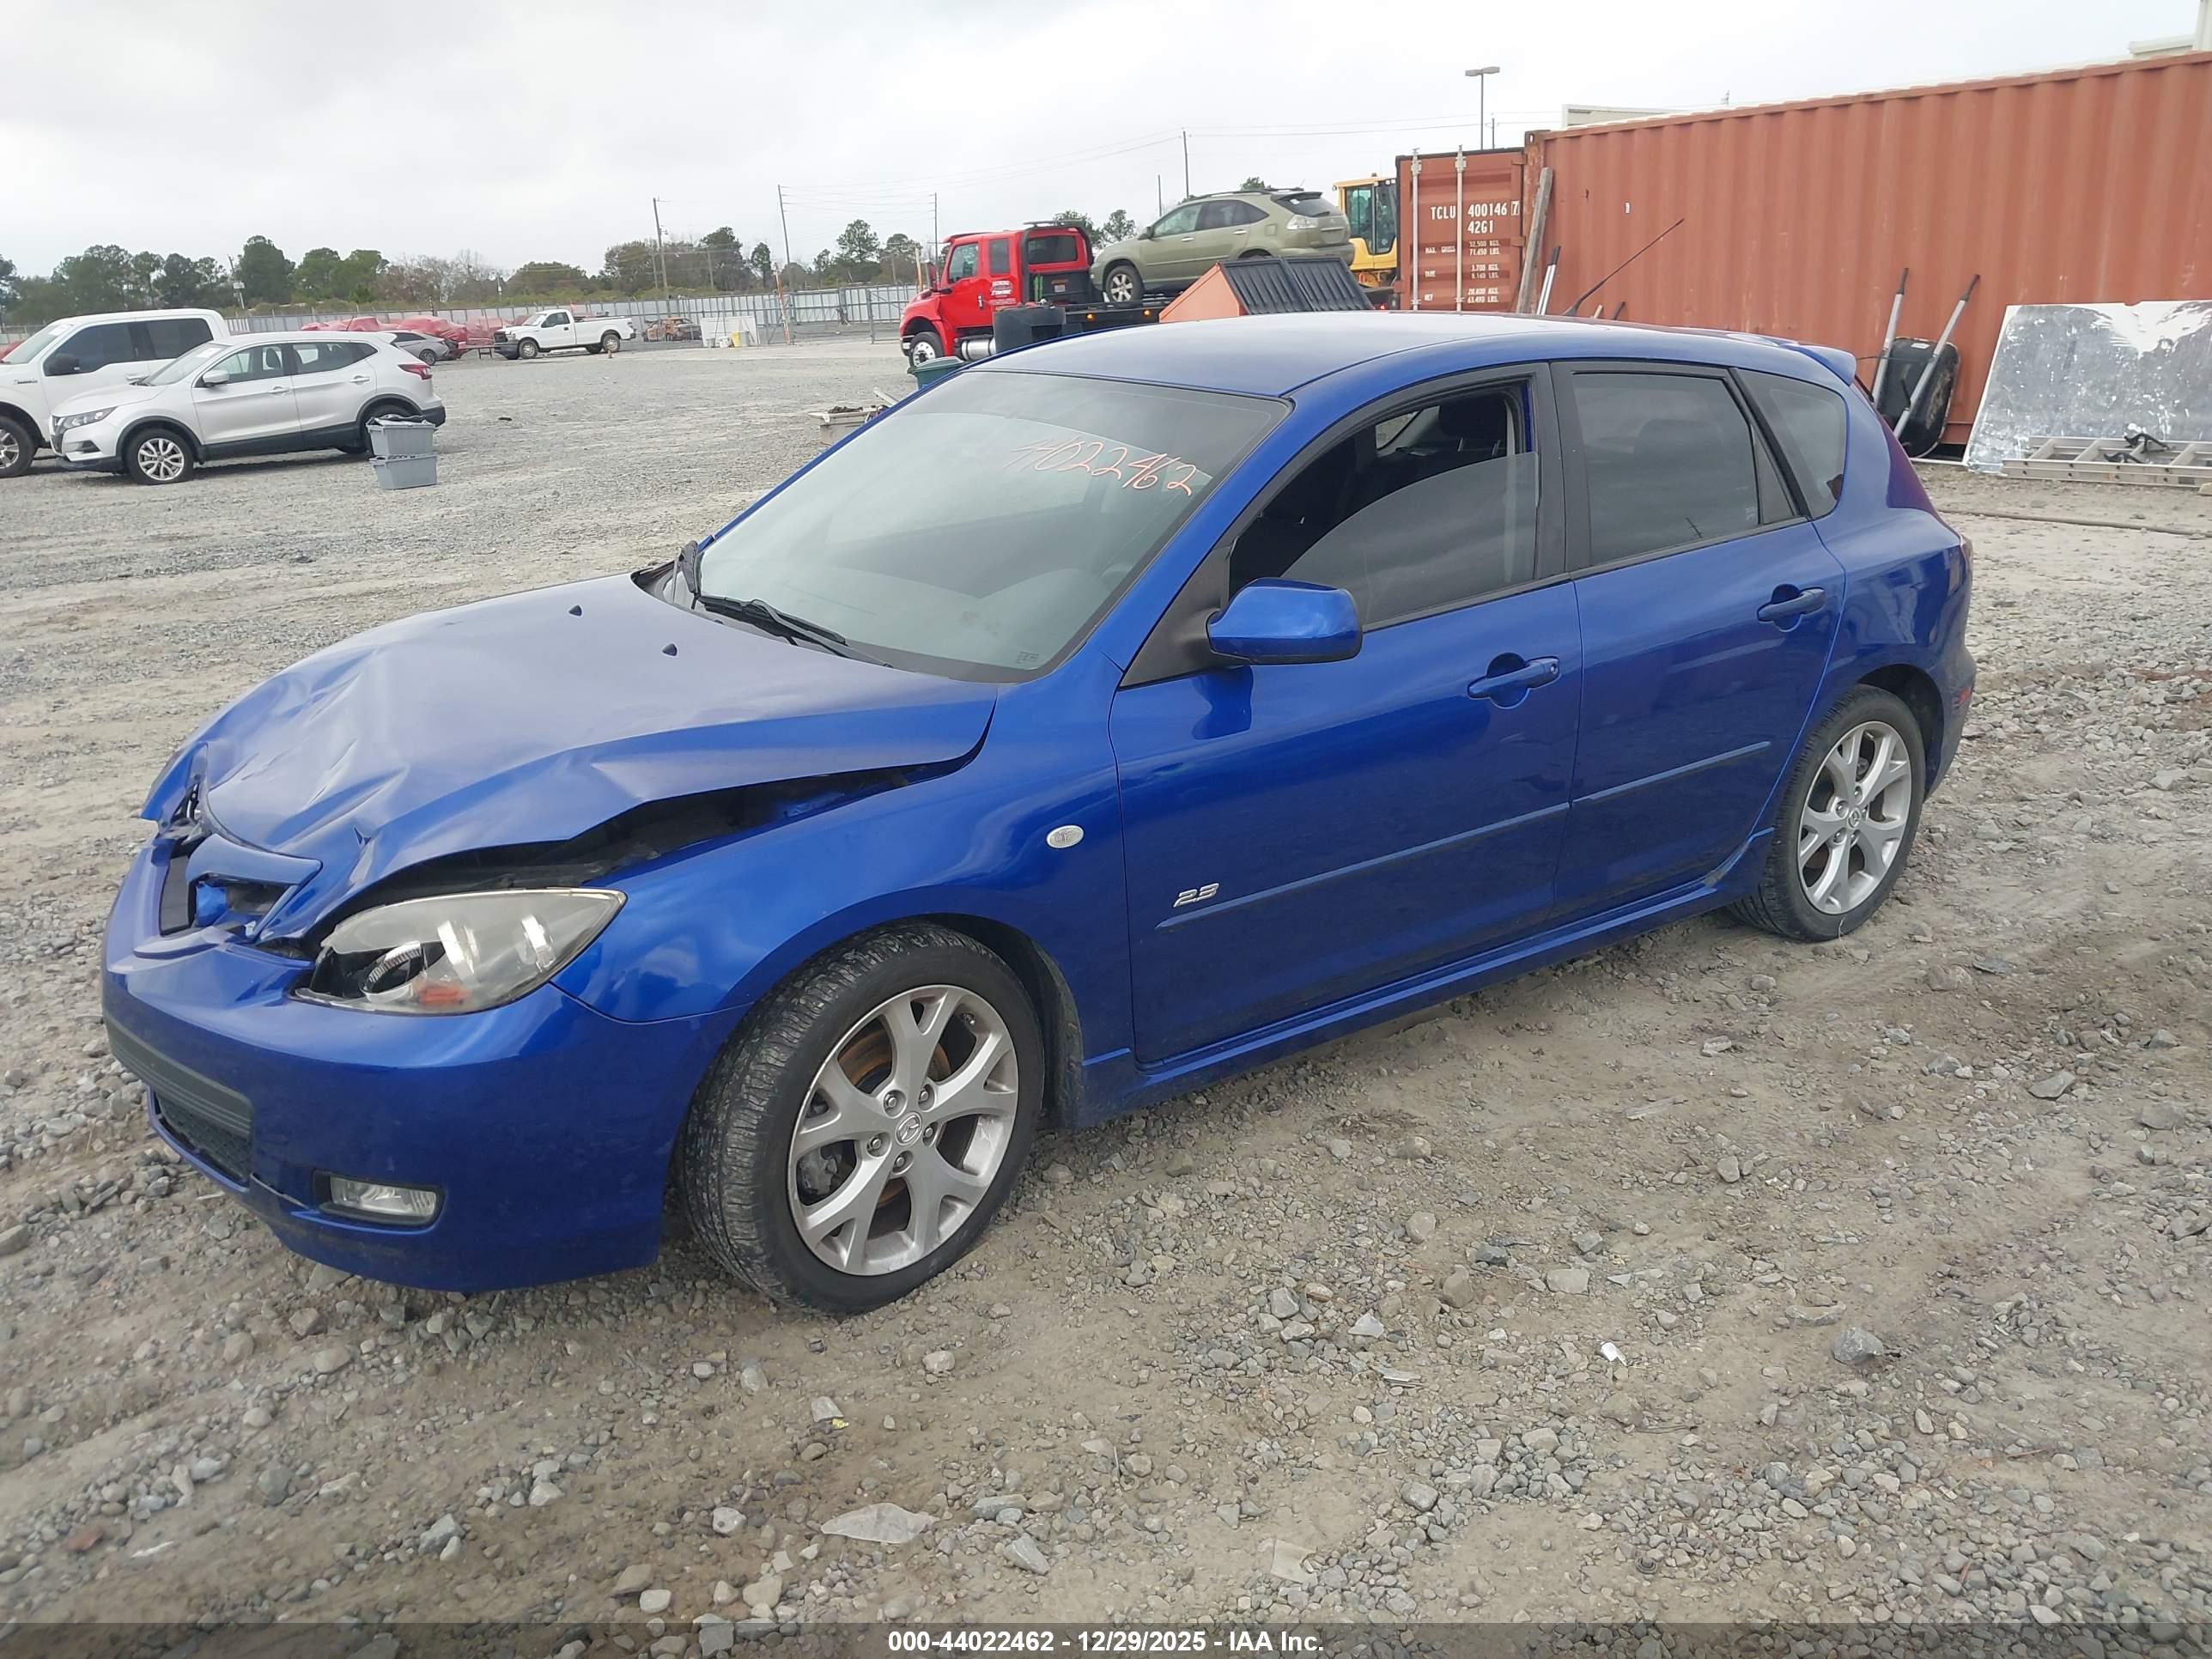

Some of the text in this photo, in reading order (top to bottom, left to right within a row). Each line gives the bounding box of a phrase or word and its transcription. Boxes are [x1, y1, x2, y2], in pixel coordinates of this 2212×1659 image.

[1431, 201, 1519, 220] TCLU 400146 7
[1468, 220, 1493, 234] 42G1
